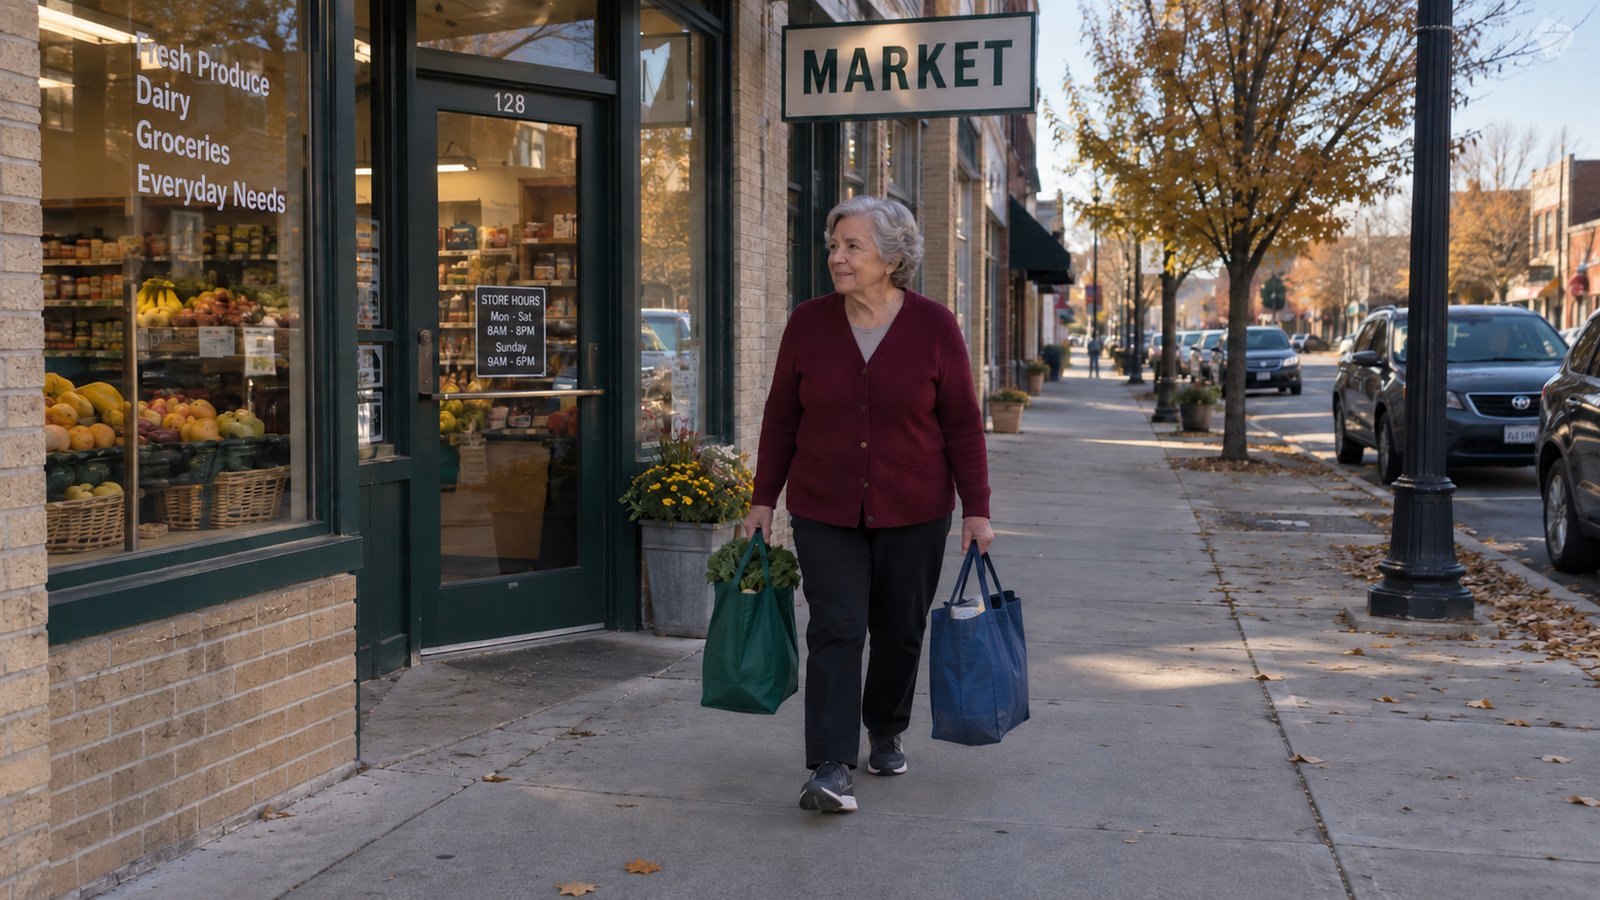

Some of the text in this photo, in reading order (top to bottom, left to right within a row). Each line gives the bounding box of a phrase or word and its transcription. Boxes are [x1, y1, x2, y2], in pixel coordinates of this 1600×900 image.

[136, 31, 270, 97] Fresh Produce
[803, 39, 1013, 95] MARKET
[136, 74, 191, 121] Dairy
[494, 92, 525, 114] 128
[136, 120, 230, 166] Groceries
[137, 163, 286, 214] Everyday Needs
[481, 295, 540, 306] STORE HOURS
[490, 311, 510, 322] Mon
[518, 311, 532, 322] Sat
[487, 325, 507, 336] 8AM
[515, 325, 535, 336] 8PM
[495, 341, 527, 354] Sunday
[487, 356, 508, 367] 9AM
[515, 356, 535, 367] 6PM
